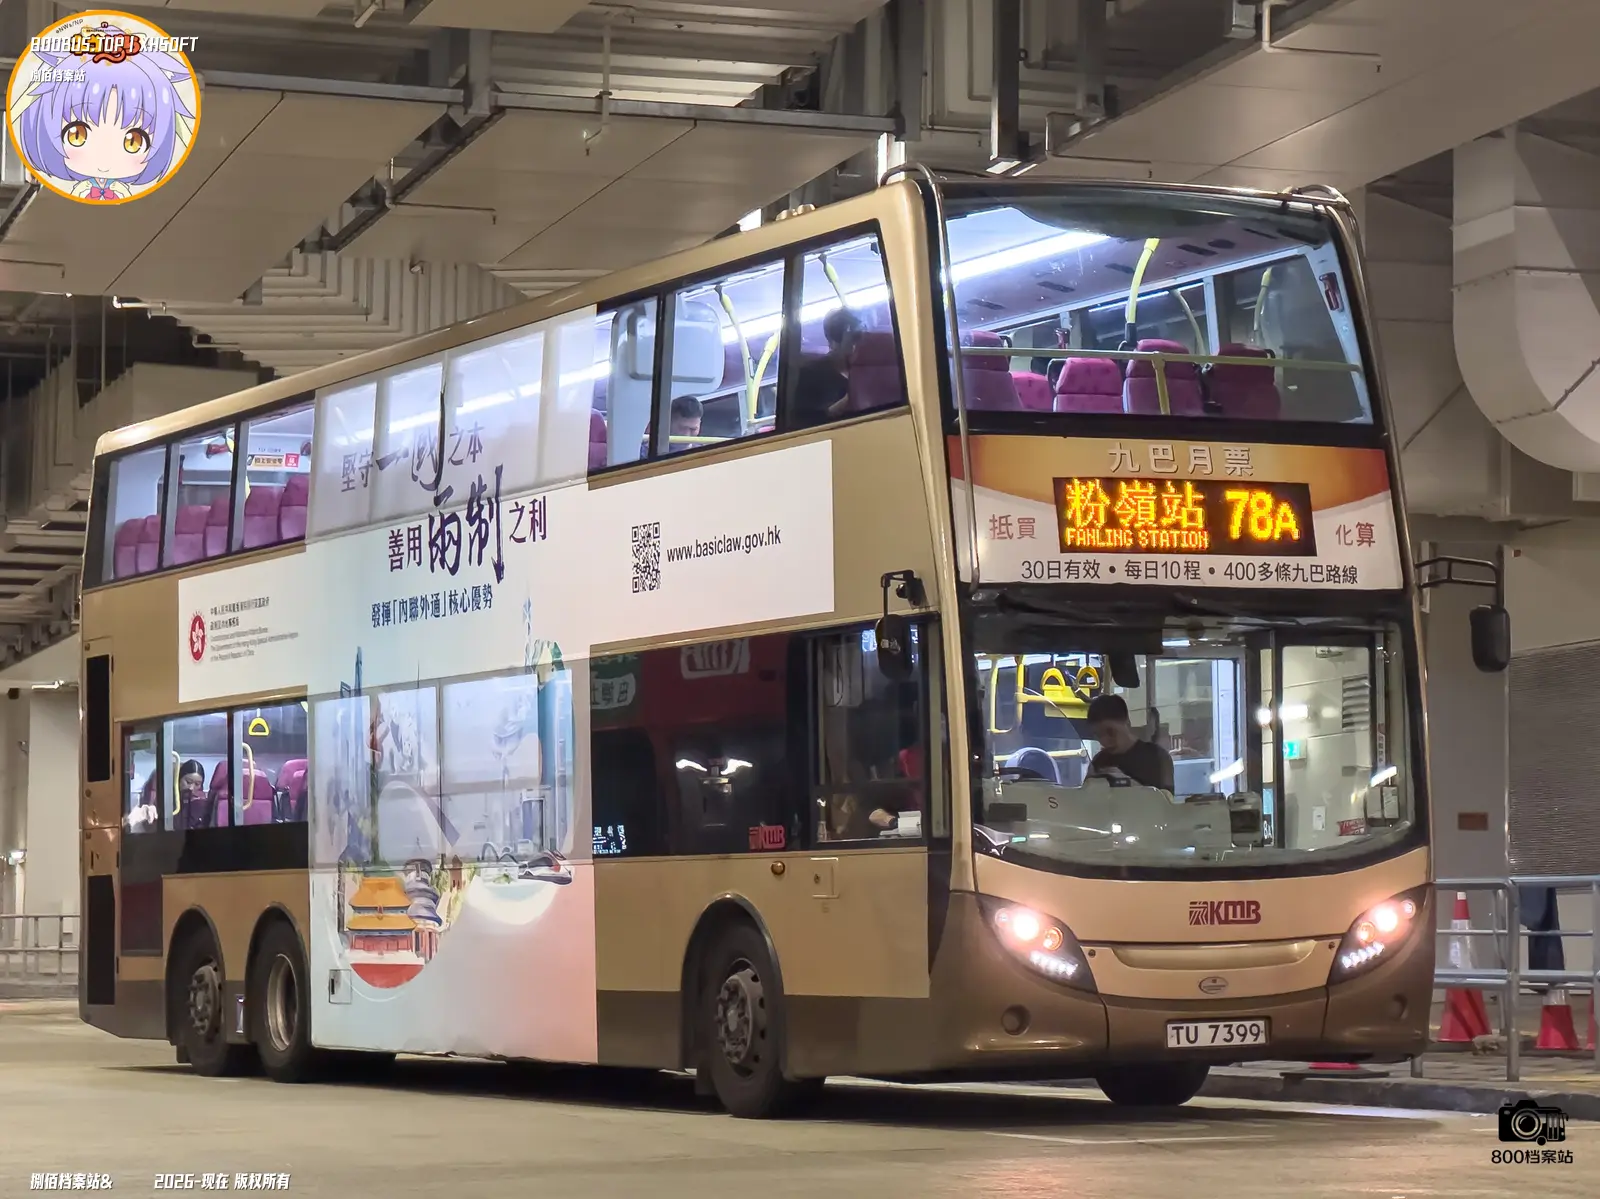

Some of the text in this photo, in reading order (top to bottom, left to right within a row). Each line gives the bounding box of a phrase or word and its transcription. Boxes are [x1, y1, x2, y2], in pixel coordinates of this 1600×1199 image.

[1108, 442, 1254, 477] 九巴月票
[1066, 478, 1205, 528] 粉嶺站
[1224, 490, 1300, 541] 78A
[988, 513, 1037, 540] 抵買
[1065, 528, 1210, 549] FANLING STATION
[1335, 521, 1377, 548] 化算
[666, 525, 782, 563] www.basiclaw.gov.hk
[1209, 900, 1262, 925] KMB
[1172, 1023, 1261, 1045] TU 7399
